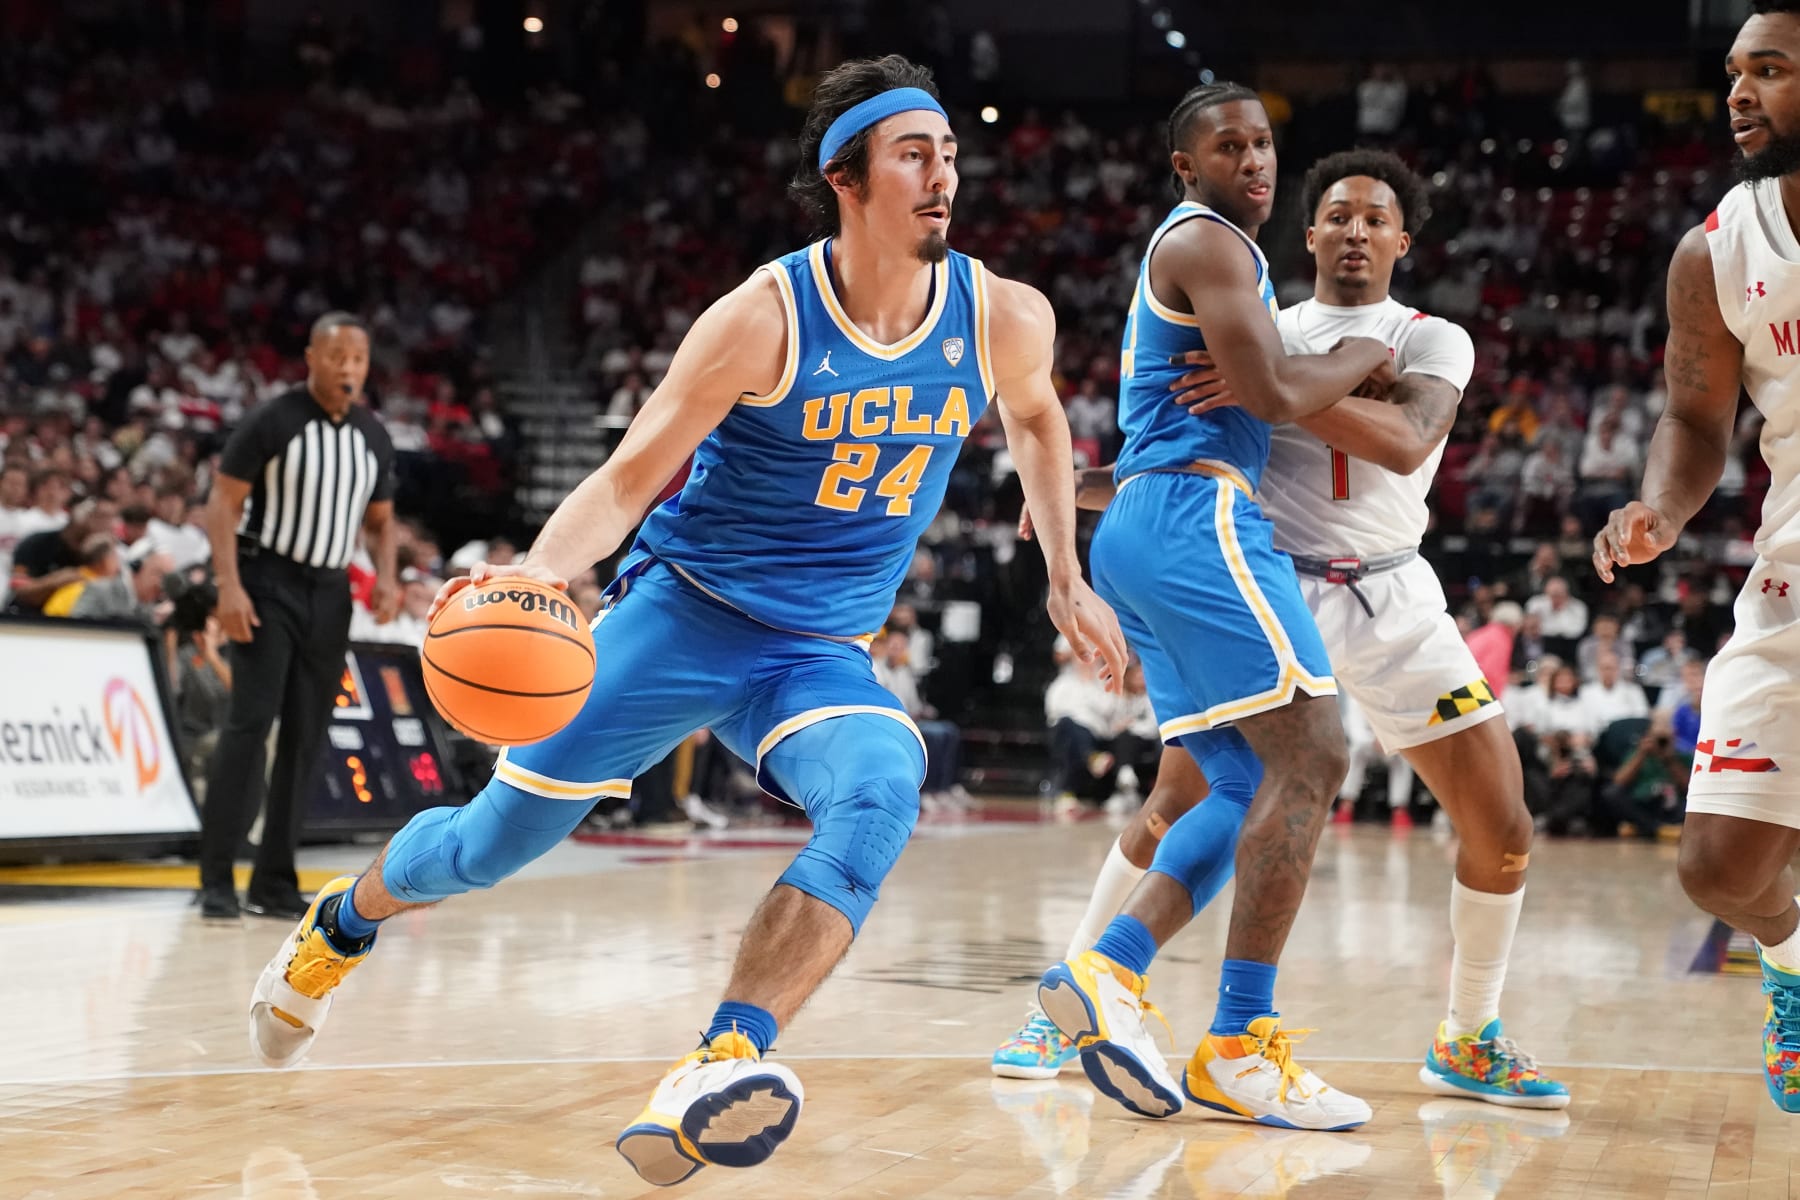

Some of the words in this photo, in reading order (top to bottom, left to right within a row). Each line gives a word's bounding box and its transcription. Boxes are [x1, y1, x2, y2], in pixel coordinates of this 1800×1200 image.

[1768, 320, 1800, 356] M
[802, 386, 971, 441] UCLA
[814, 442, 934, 516] 24
[1326, 444, 1349, 500] 1
[464, 590, 578, 632] Wilson
[0, 706, 112, 765] eznick
